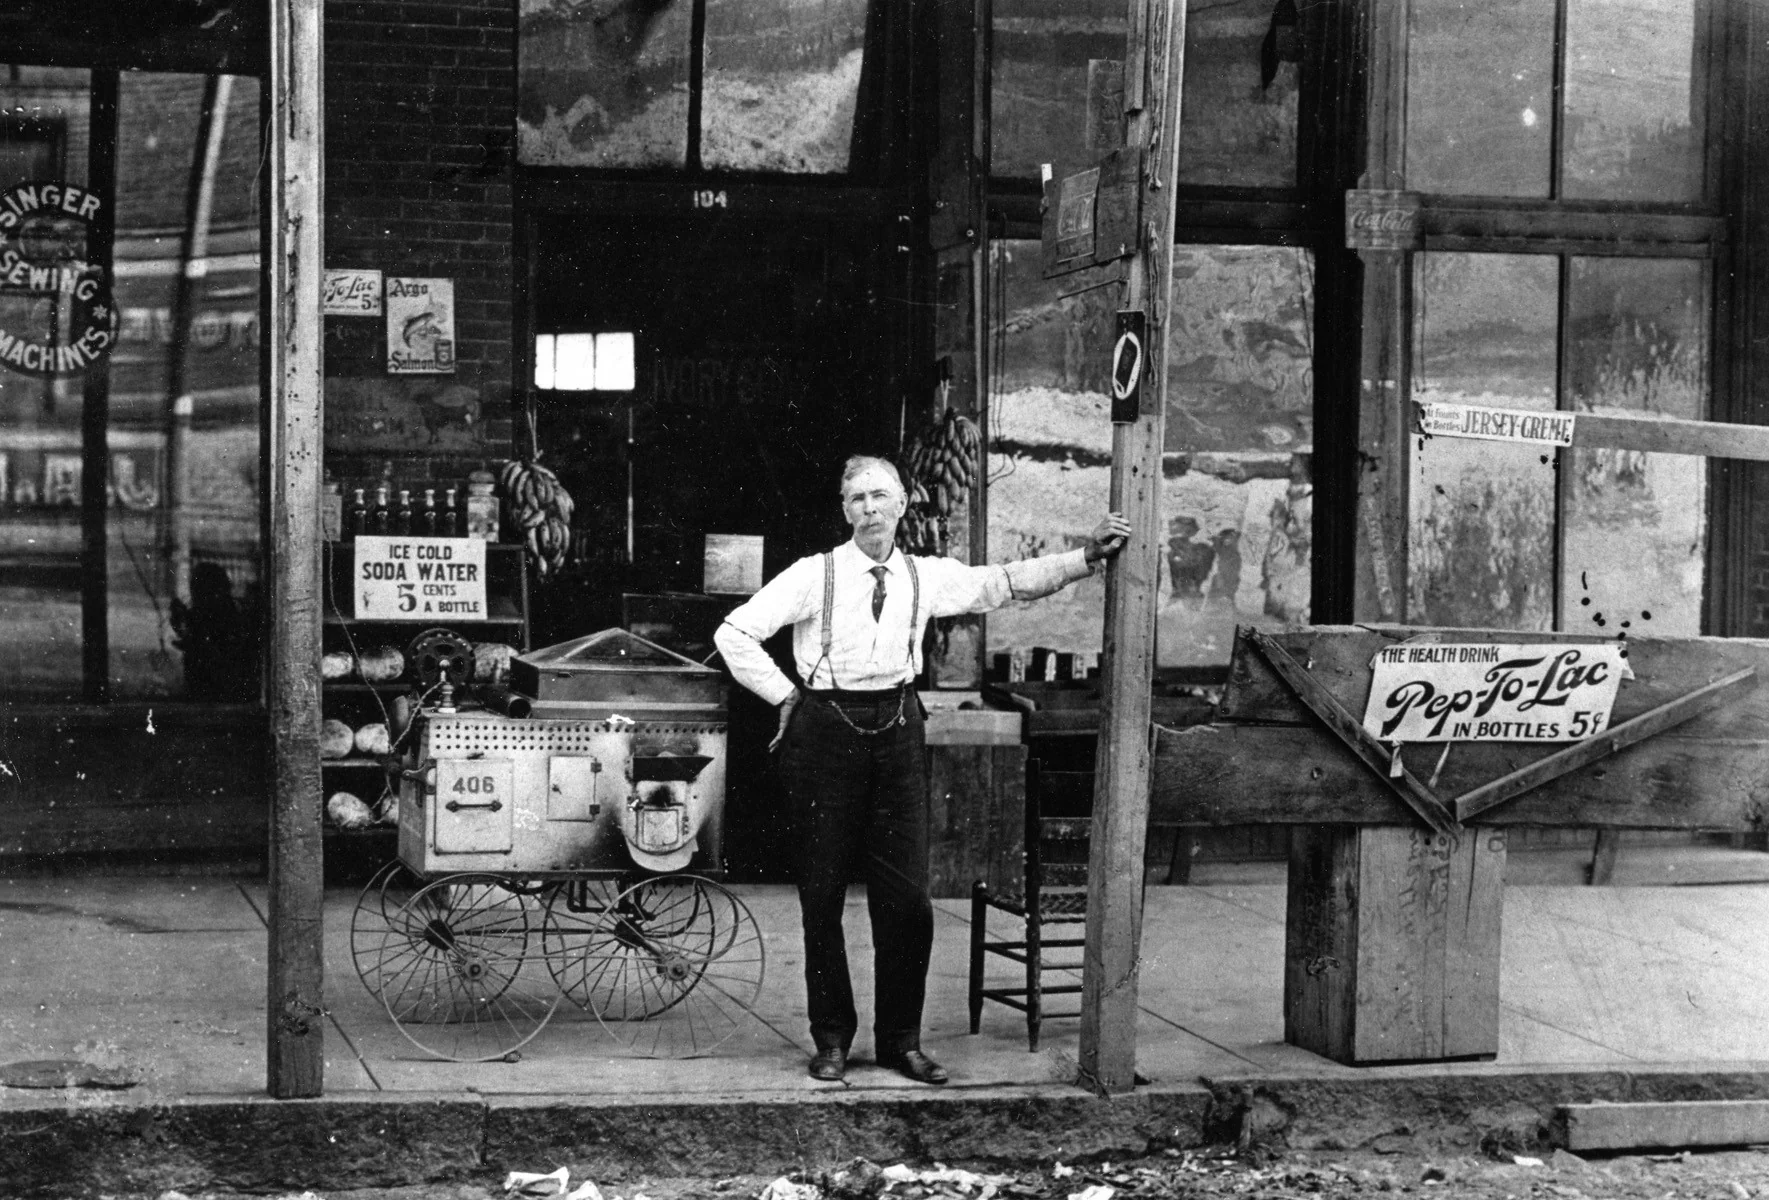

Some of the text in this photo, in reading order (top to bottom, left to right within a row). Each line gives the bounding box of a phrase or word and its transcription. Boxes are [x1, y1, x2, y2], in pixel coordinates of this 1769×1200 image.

[0, 185, 100, 227] SINGER
[693, 190, 727, 208] 104
[0, 250, 98, 301] SEWING
[390, 279, 428, 298] Argo
[0, 326, 110, 371] MACHINES
[389, 544, 452, 560] ICE COLD
[362, 562, 478, 581] SODA WATER
[397, 583, 457, 612] 5 CENTS
[424, 601, 480, 613] A BOTTLE
[1381, 646, 1500, 664] THE HEALTH DRINK
[1379, 649, 1609, 738] Pep-To-Lac
[1452, 722, 1471, 738] IN
[1475, 722, 1560, 738] BOTTLES
[452, 776, 495, 794] 406
